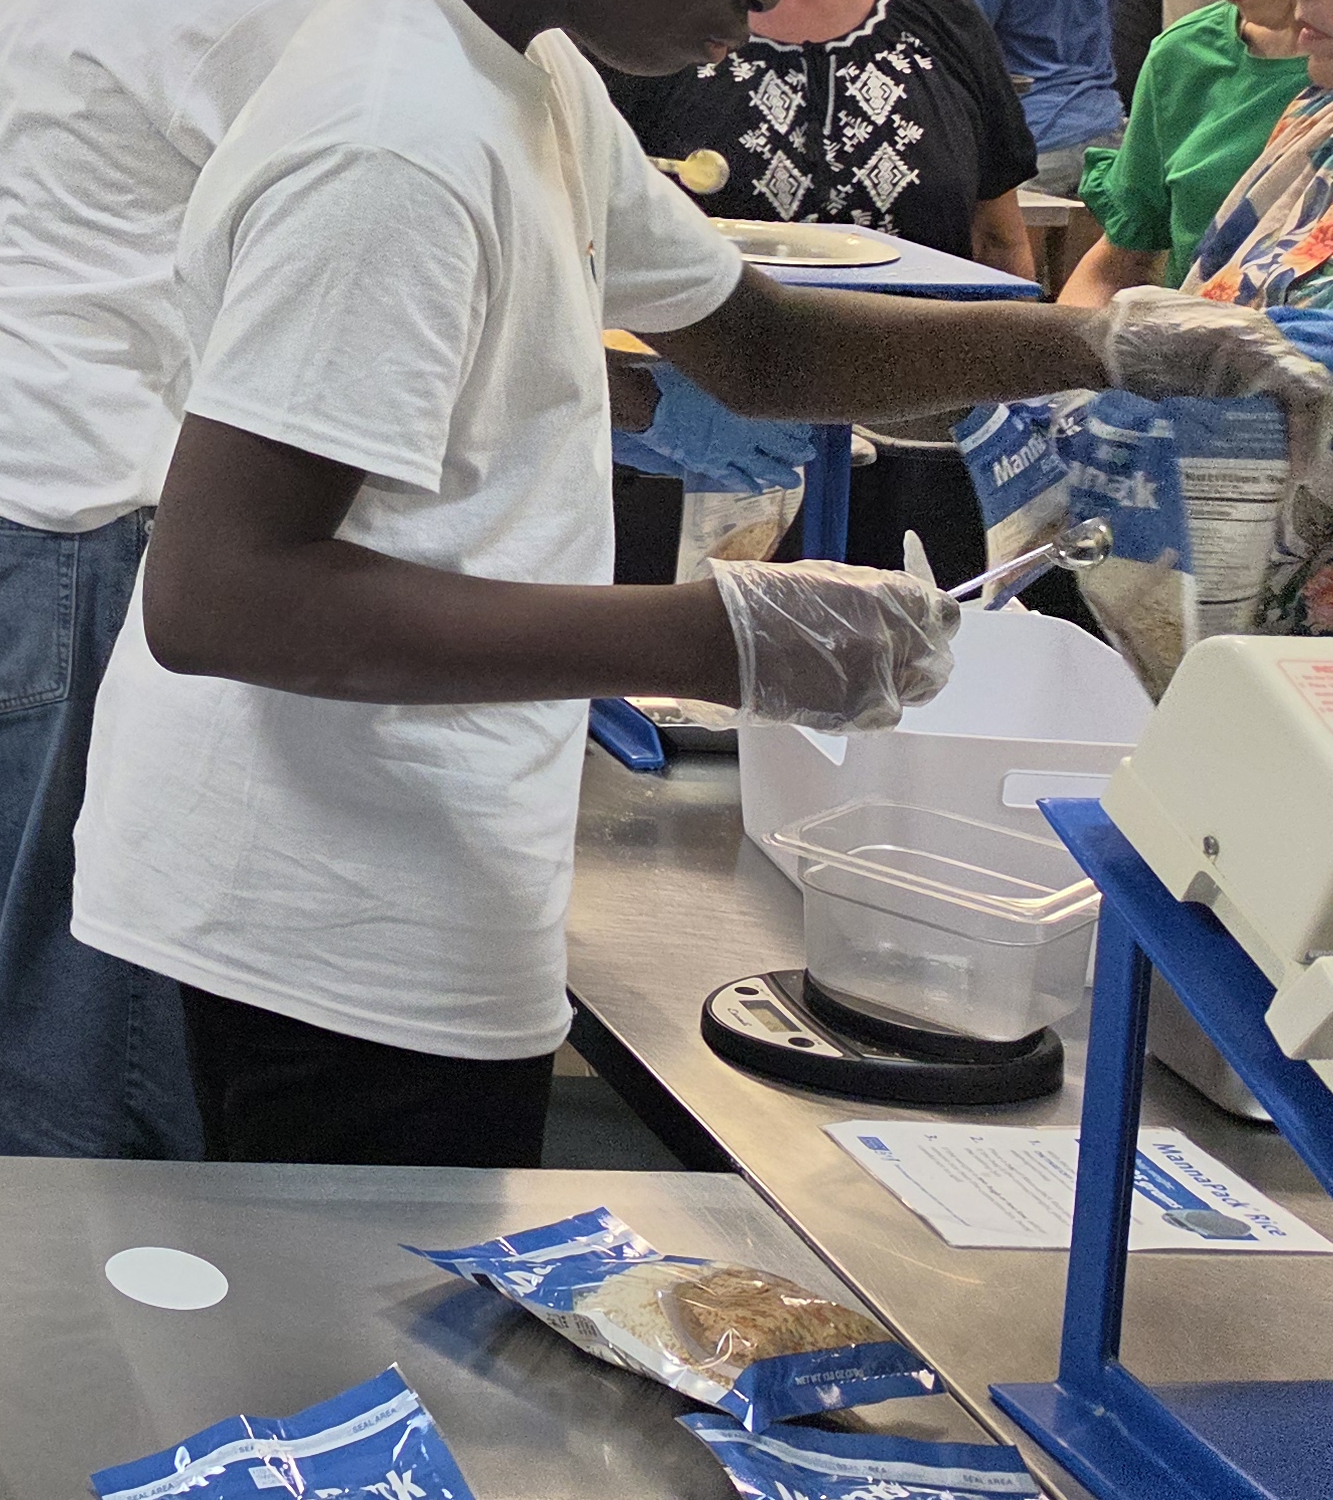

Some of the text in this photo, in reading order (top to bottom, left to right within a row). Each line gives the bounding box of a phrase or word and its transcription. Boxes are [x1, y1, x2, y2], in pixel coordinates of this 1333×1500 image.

[1152, 1143, 1287, 1237] MannaPack Rice
[352, 1407, 397, 1434] SEAL AREA
[150, 1482, 175, 1498] AREA
